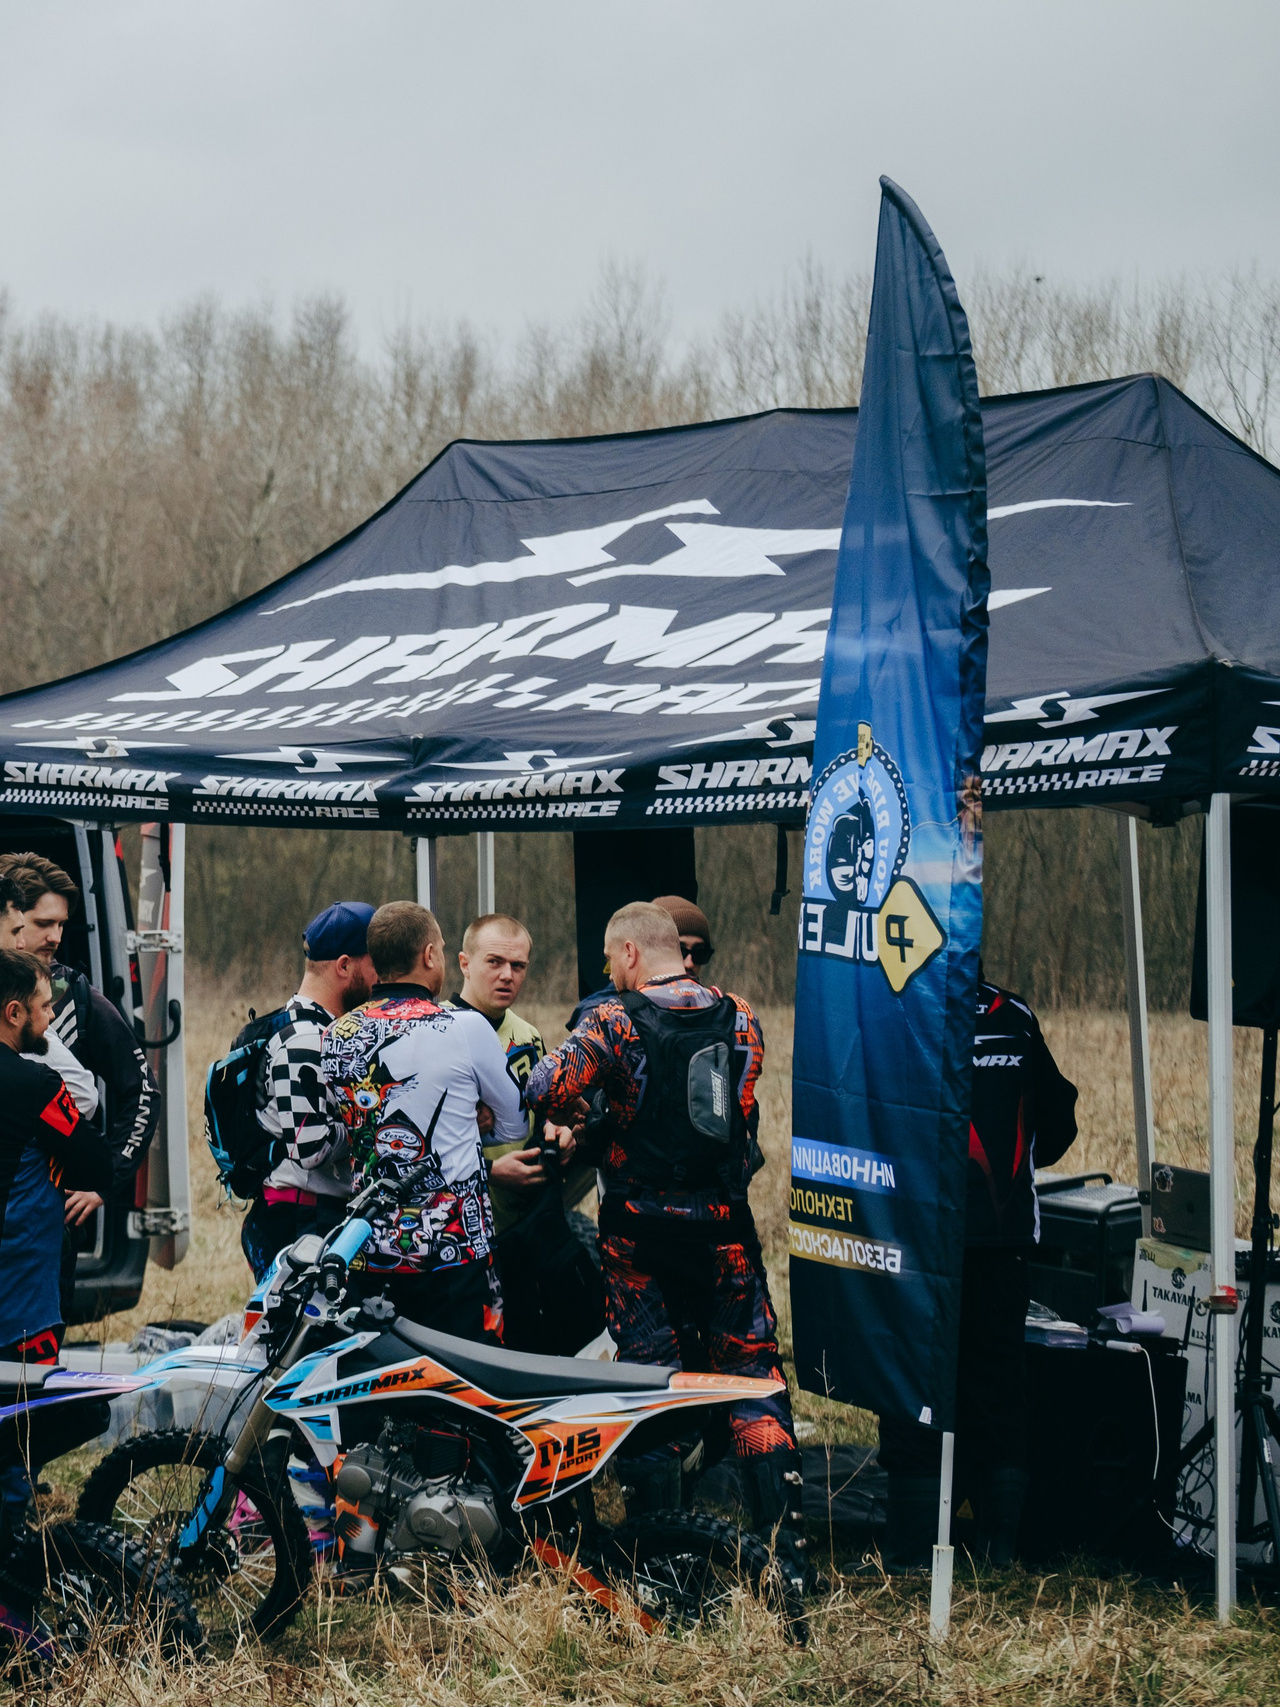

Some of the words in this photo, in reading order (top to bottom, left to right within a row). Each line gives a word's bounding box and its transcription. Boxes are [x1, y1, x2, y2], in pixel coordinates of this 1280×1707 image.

[107, 603, 832, 701] SHARMA
[530, 678, 821, 714] RAC
[980, 726, 1178, 772] ARMAX
[4, 761, 181, 793] SHARMAX
[192, 774, 390, 801] SHARMAX
[405, 768, 626, 802] SHARMAX
[655, 756, 814, 790] SHARM
[1074, 764, 1166, 788] RACE
[111, 794, 169, 810] RACE
[315, 806, 380, 818] RACE
[547, 801, 621, 817] RACE
[297, 1367, 427, 1408] SHARMAX
[539, 1427, 601, 1468] 145
[558, 1449, 601, 1472] SPORT
